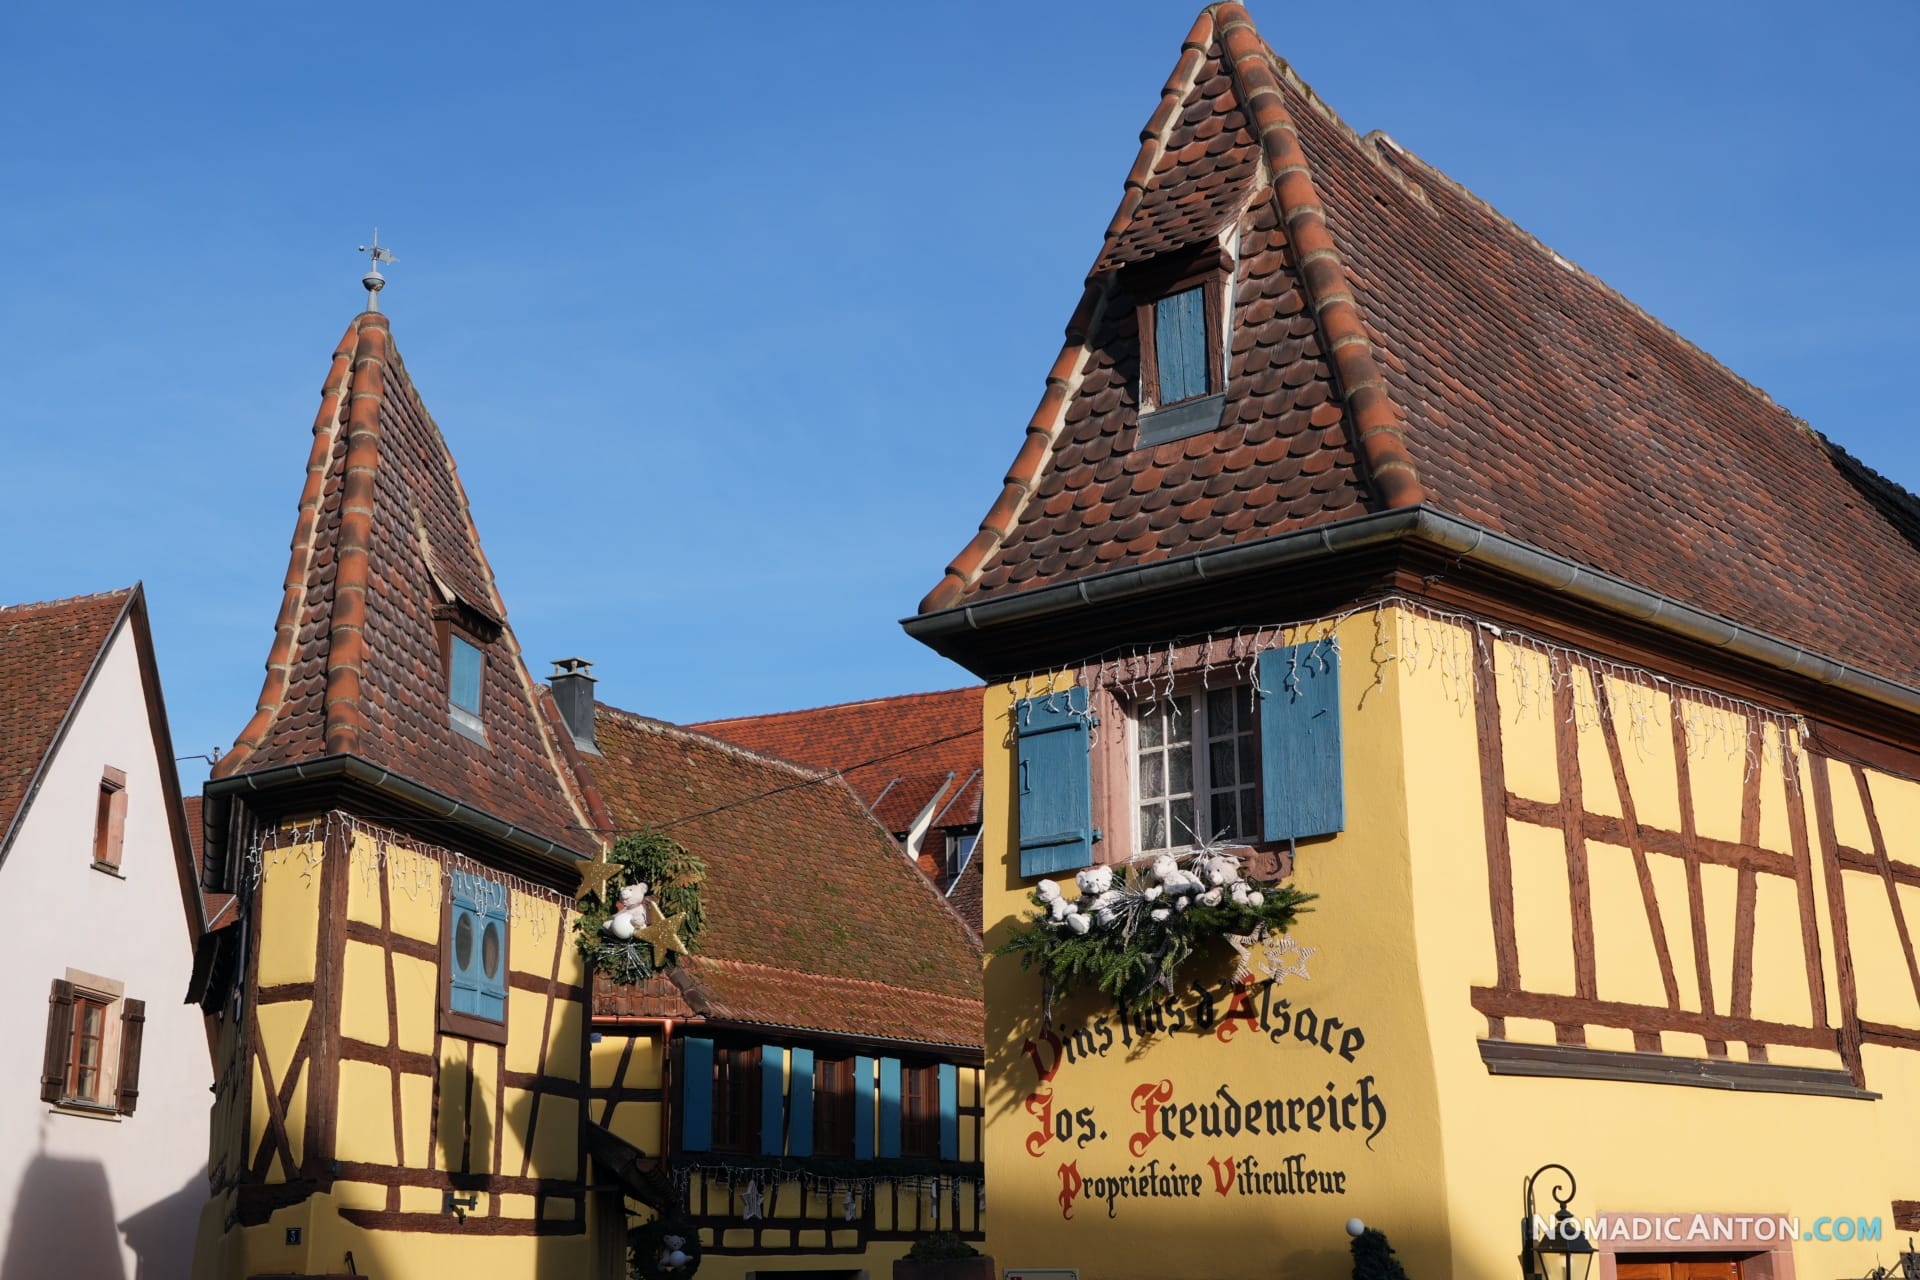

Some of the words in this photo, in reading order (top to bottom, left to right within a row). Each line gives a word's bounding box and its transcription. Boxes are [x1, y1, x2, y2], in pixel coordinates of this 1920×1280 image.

[1021, 1016, 1114, 1082] Vins
[1190, 973, 1366, 1063] d'Alsace
[1025, 1088, 1108, 1157] Jos.
[1129, 1075, 1387, 1156] Freudenreich
[1057, 1159, 1203, 1221] Propriétaire
[1206, 1153, 1347, 1197] Viticulteur
